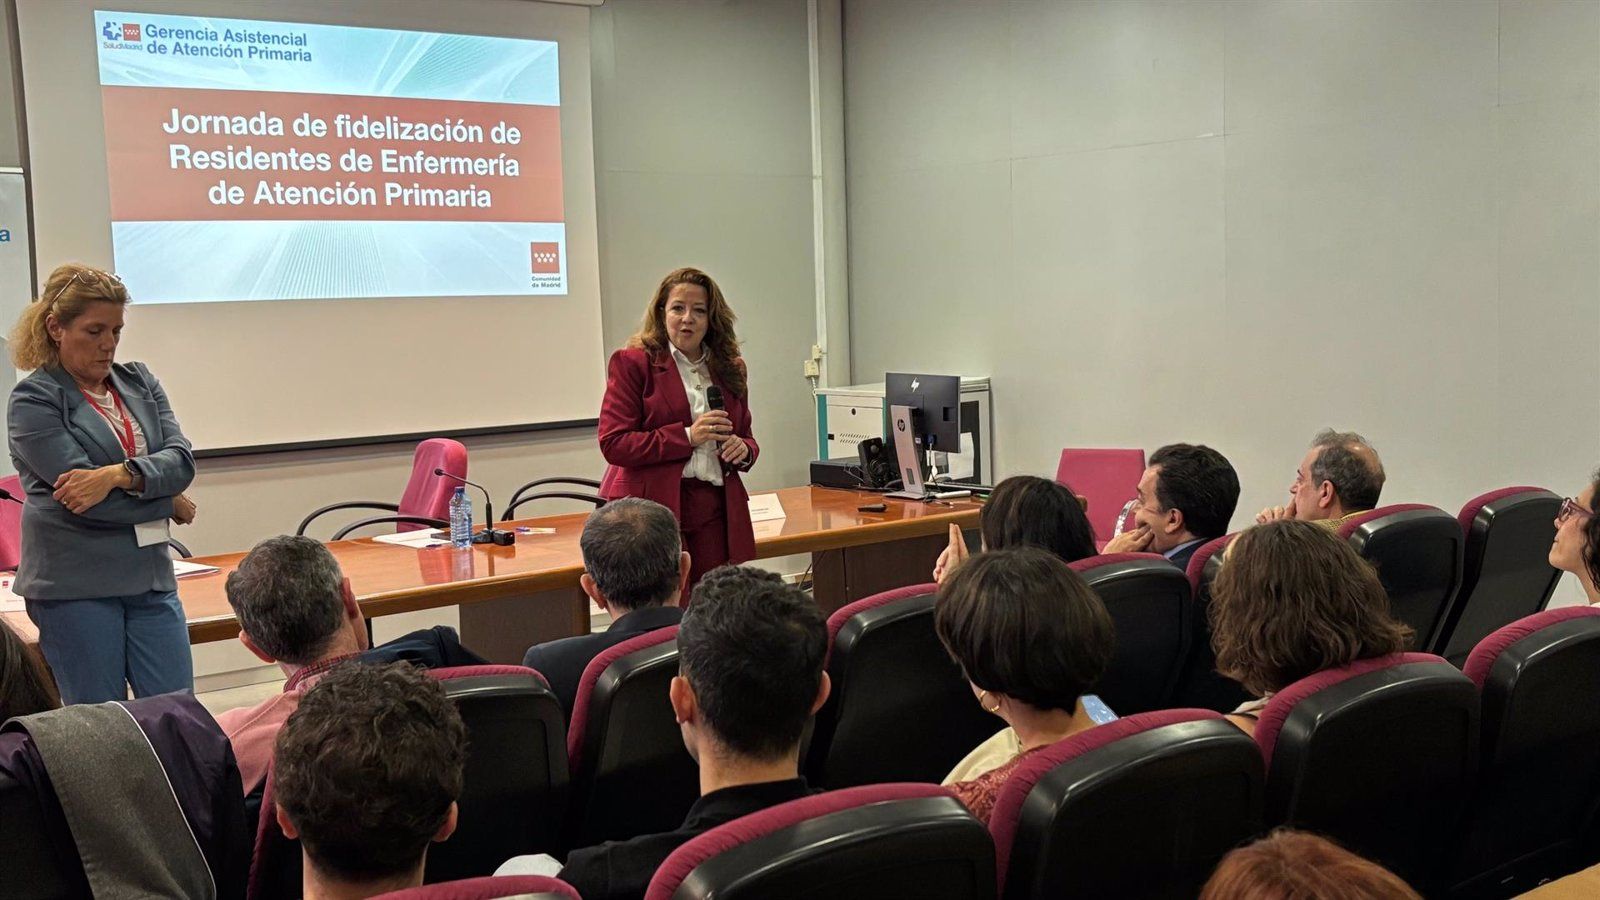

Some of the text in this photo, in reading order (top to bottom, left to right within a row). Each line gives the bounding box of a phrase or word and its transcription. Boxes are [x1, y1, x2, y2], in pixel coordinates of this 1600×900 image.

[145, 24, 307, 47] Gerencia Asistencial
[147, 41, 312, 62] de Atención Primaria
[162, 108, 522, 145] Jornada de fidelización de
[169, 143, 520, 177] Residentes de Enfermería
[208, 180, 492, 208] de Atención Primaria
